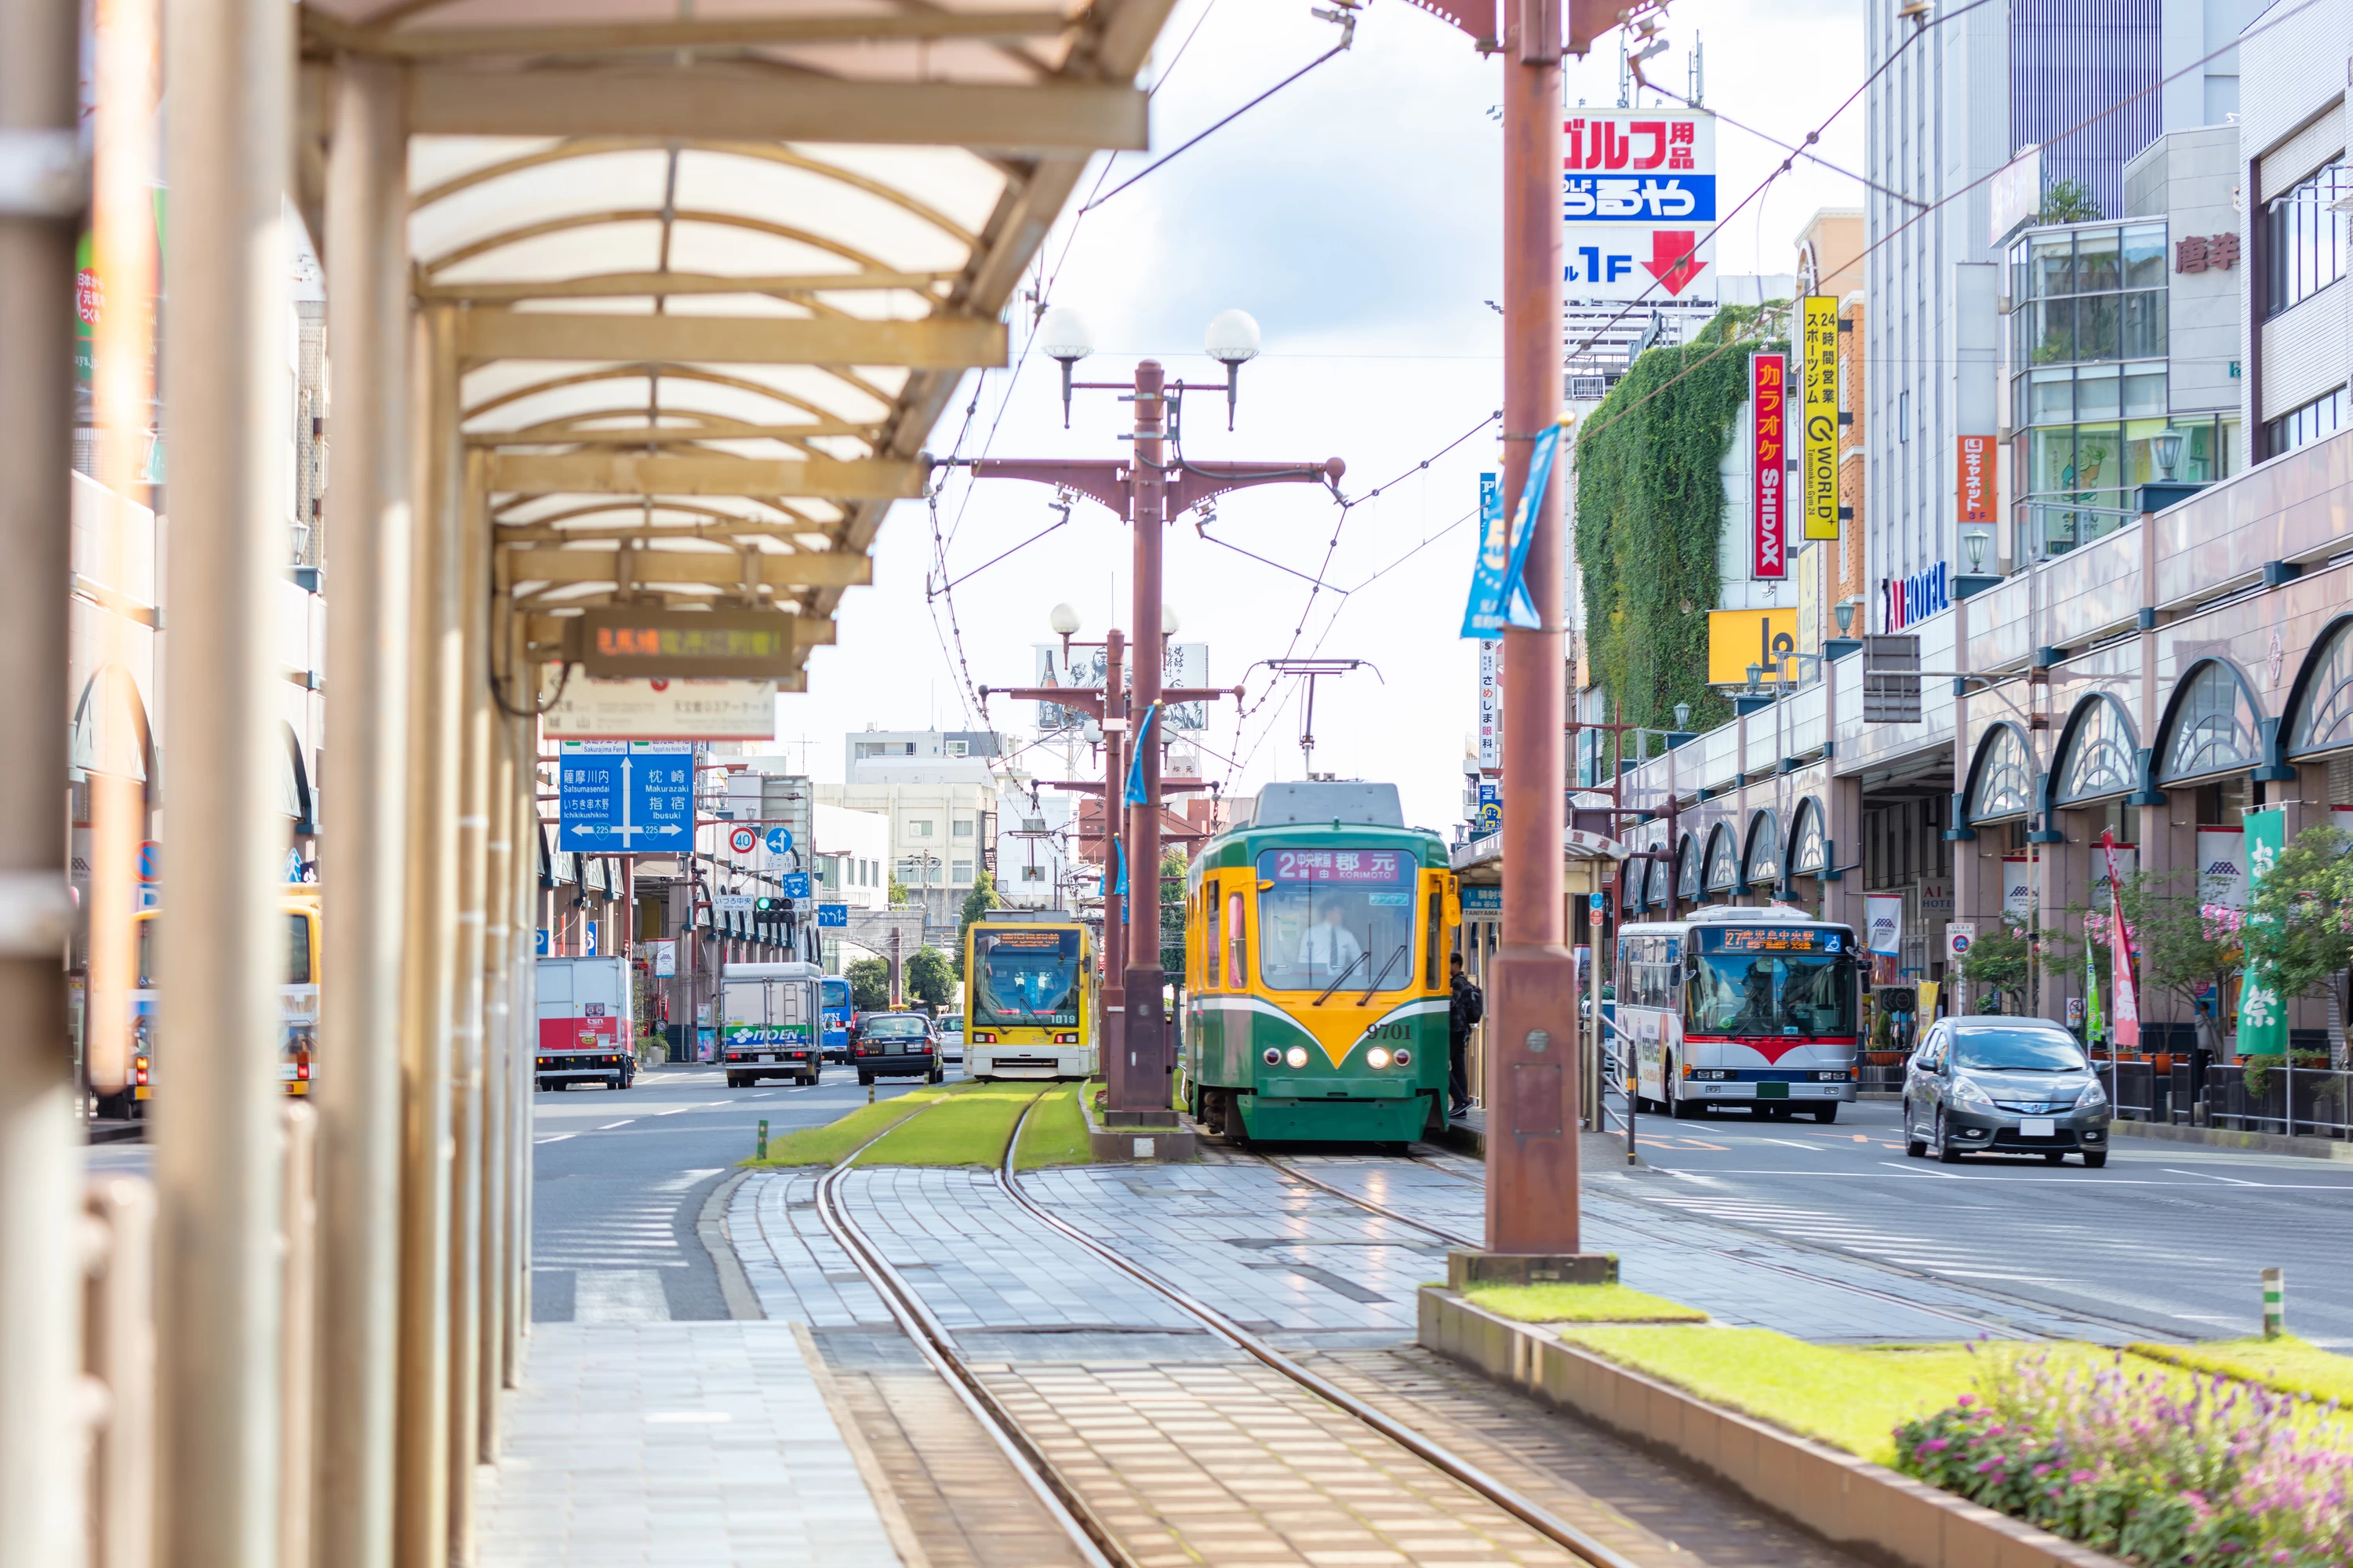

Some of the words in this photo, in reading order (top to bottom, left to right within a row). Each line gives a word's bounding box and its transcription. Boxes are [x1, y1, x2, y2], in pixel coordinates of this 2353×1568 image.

[1669, 122, 1694, 169] 用品
[1807, 314, 1819, 405] スポーツジム
[1821, 313, 1835, 404] 24時間営業
[1758, 365, 1780, 461] カラオケ
[1806, 490, 1816, 506] Gym
[1762, 468, 1779, 567] SHIDAX
[1904, 561, 1947, 627] HOTEL
[1482, 675, 1493, 748] さめしま眼科
[564, 769, 609, 784] 薩摩川内
[649, 769, 685, 784] 枕崎
[564, 799, 609, 810] いちき串木野
[649, 796, 685, 810] 指宿
[736, 835, 751, 846] 40
[1279, 853, 1295, 877] 2
[1297, 853, 1331, 868] 中央駅前
[1336, 853, 1395, 871] 郡元
[1299, 869, 1329, 879] 経由
[1923, 886, 1941, 897] AI
[1726, 933, 1742, 945] 27
[1050, 1015, 1076, 1024] 1019
[1367, 1024, 1412, 1040] 9701
